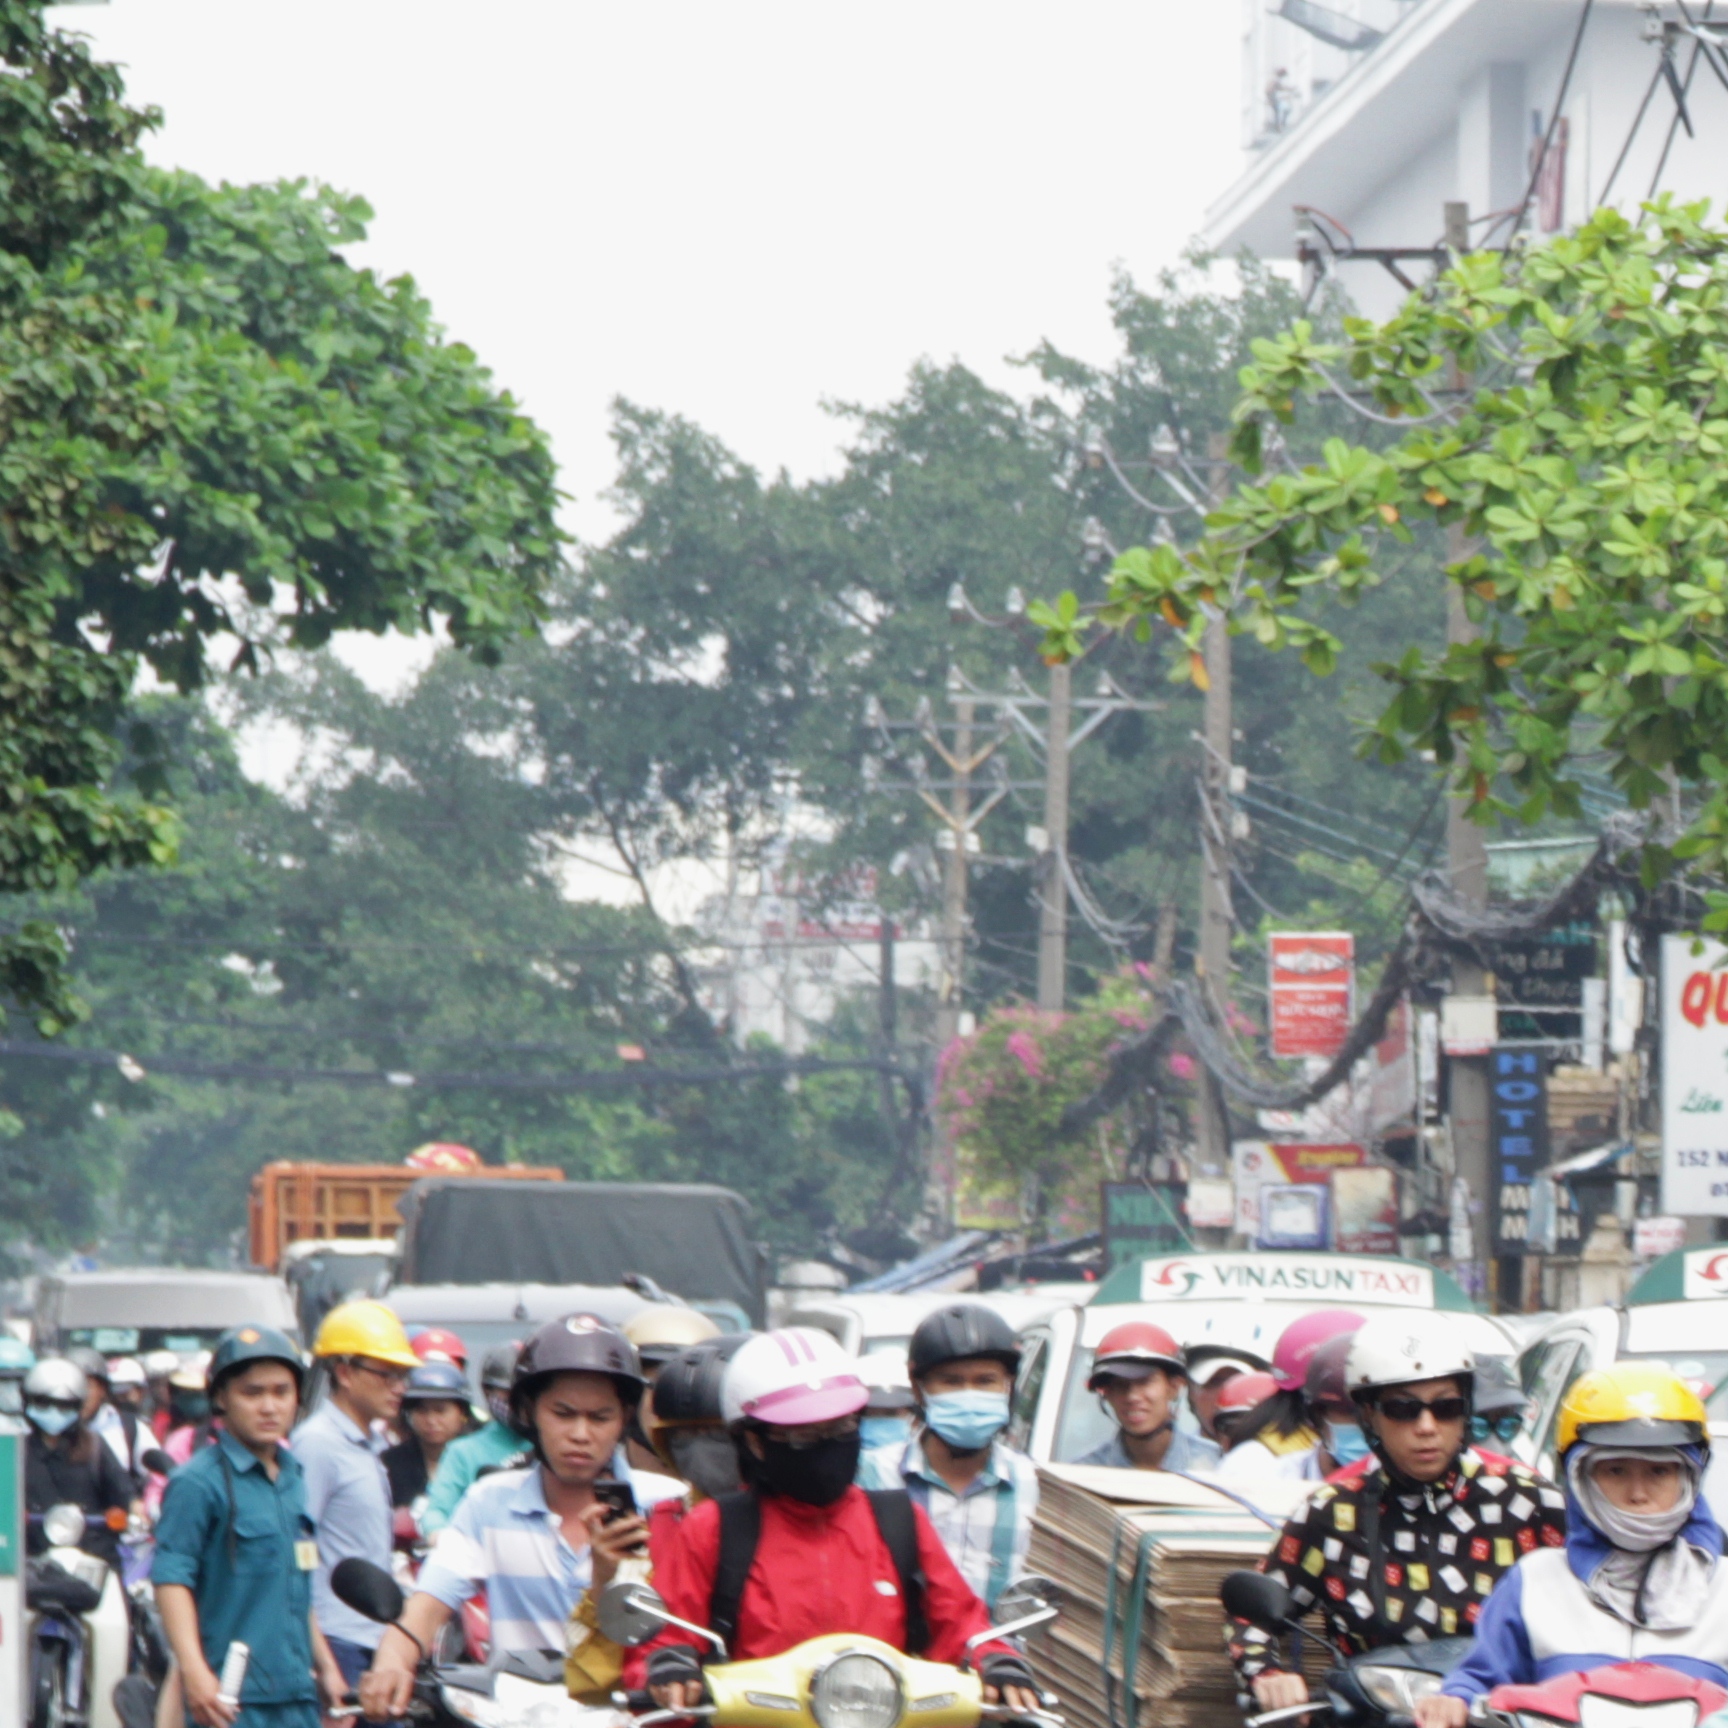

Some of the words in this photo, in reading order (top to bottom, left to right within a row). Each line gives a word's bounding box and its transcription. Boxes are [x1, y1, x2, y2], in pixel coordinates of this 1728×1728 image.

[1495, 1053, 1540, 1184] HOTEL
[1214, 1265, 1353, 1290] VINASUN
[1361, 1269, 1421, 1296] TAXI
